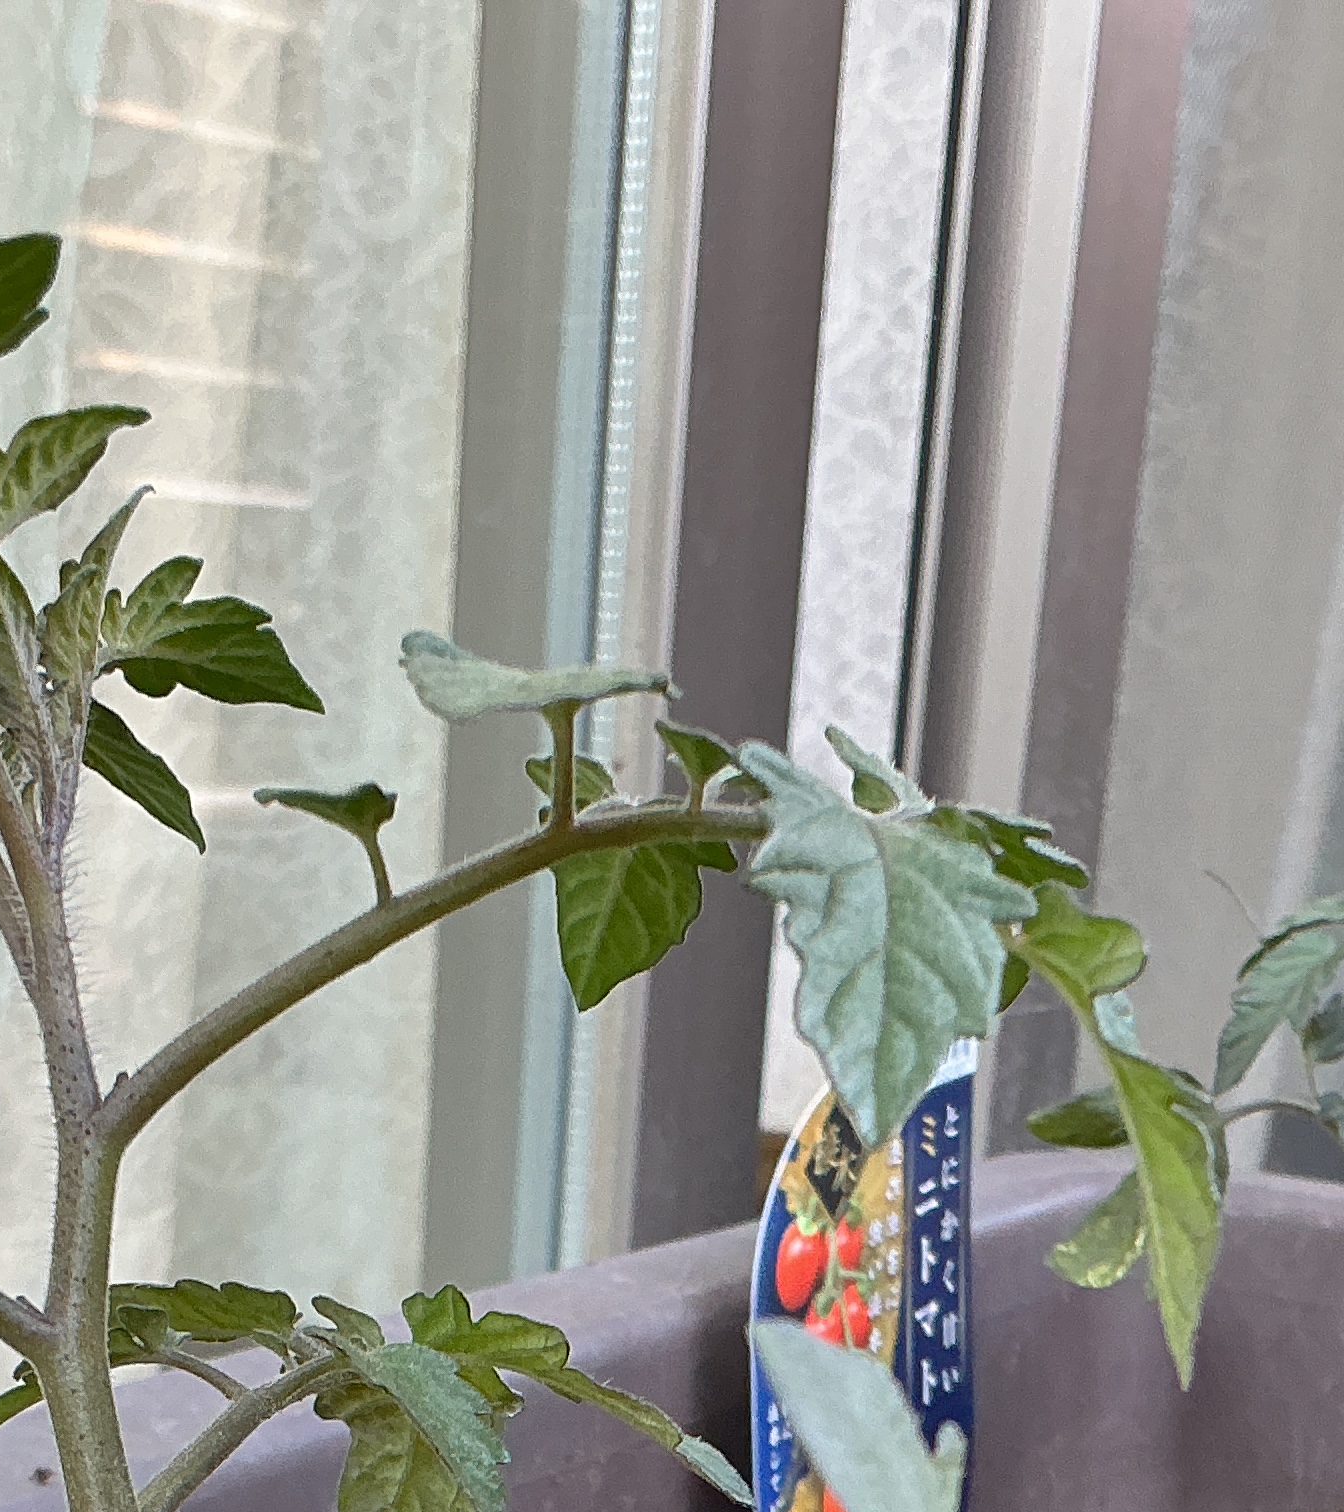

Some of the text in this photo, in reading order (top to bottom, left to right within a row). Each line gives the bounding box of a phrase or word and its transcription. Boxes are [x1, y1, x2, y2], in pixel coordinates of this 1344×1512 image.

[914, 1115, 940, 1406] ミニトマト
